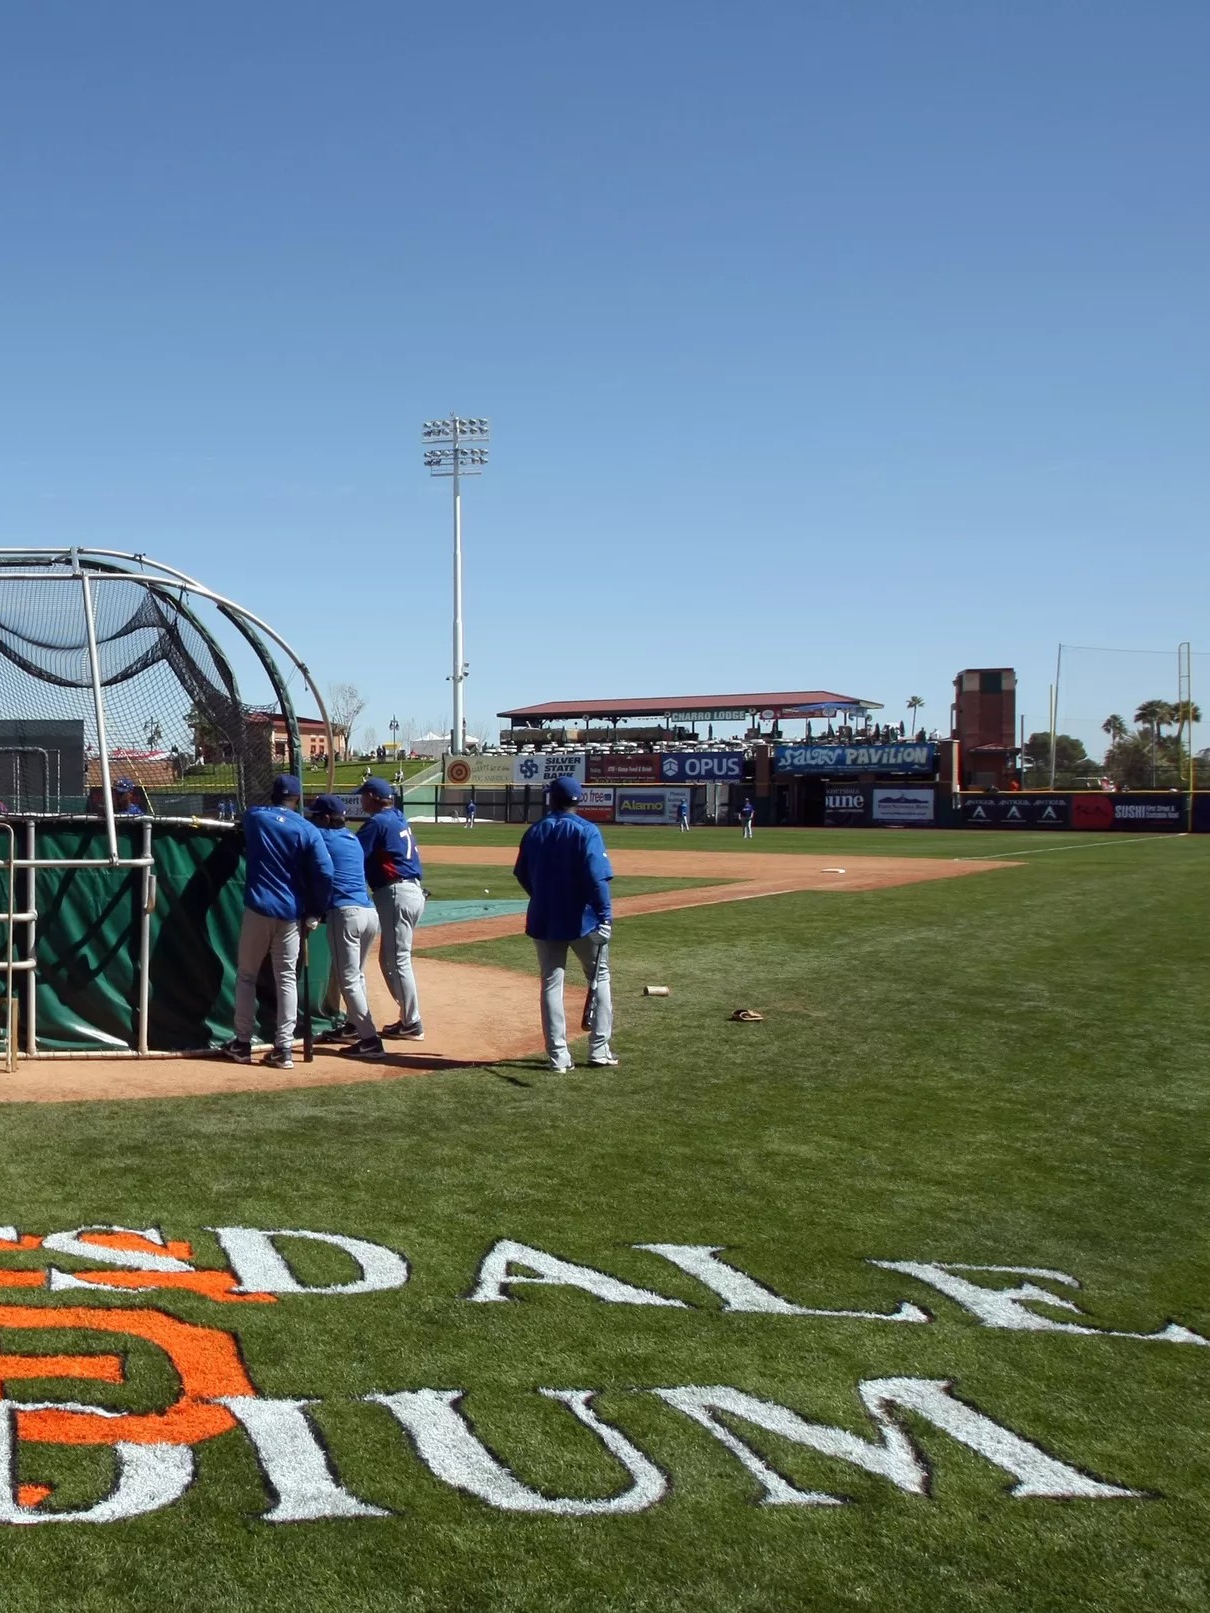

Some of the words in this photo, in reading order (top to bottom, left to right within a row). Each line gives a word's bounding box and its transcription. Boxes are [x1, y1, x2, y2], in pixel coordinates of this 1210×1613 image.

[672, 712, 712, 722] CHARRO
[713, 711, 745, 720] LODGE
[545, 756, 581, 764] SILVER
[544, 764, 576, 772] STATE
[685, 758, 740, 776] OPUS
[543, 772, 574, 780] BANK
[337, 796, 360, 805] esert
[589, 789, 604, 803] free
[620, 799, 663, 810] Alamo
[1115, 805, 1145, 819] SUSHI
